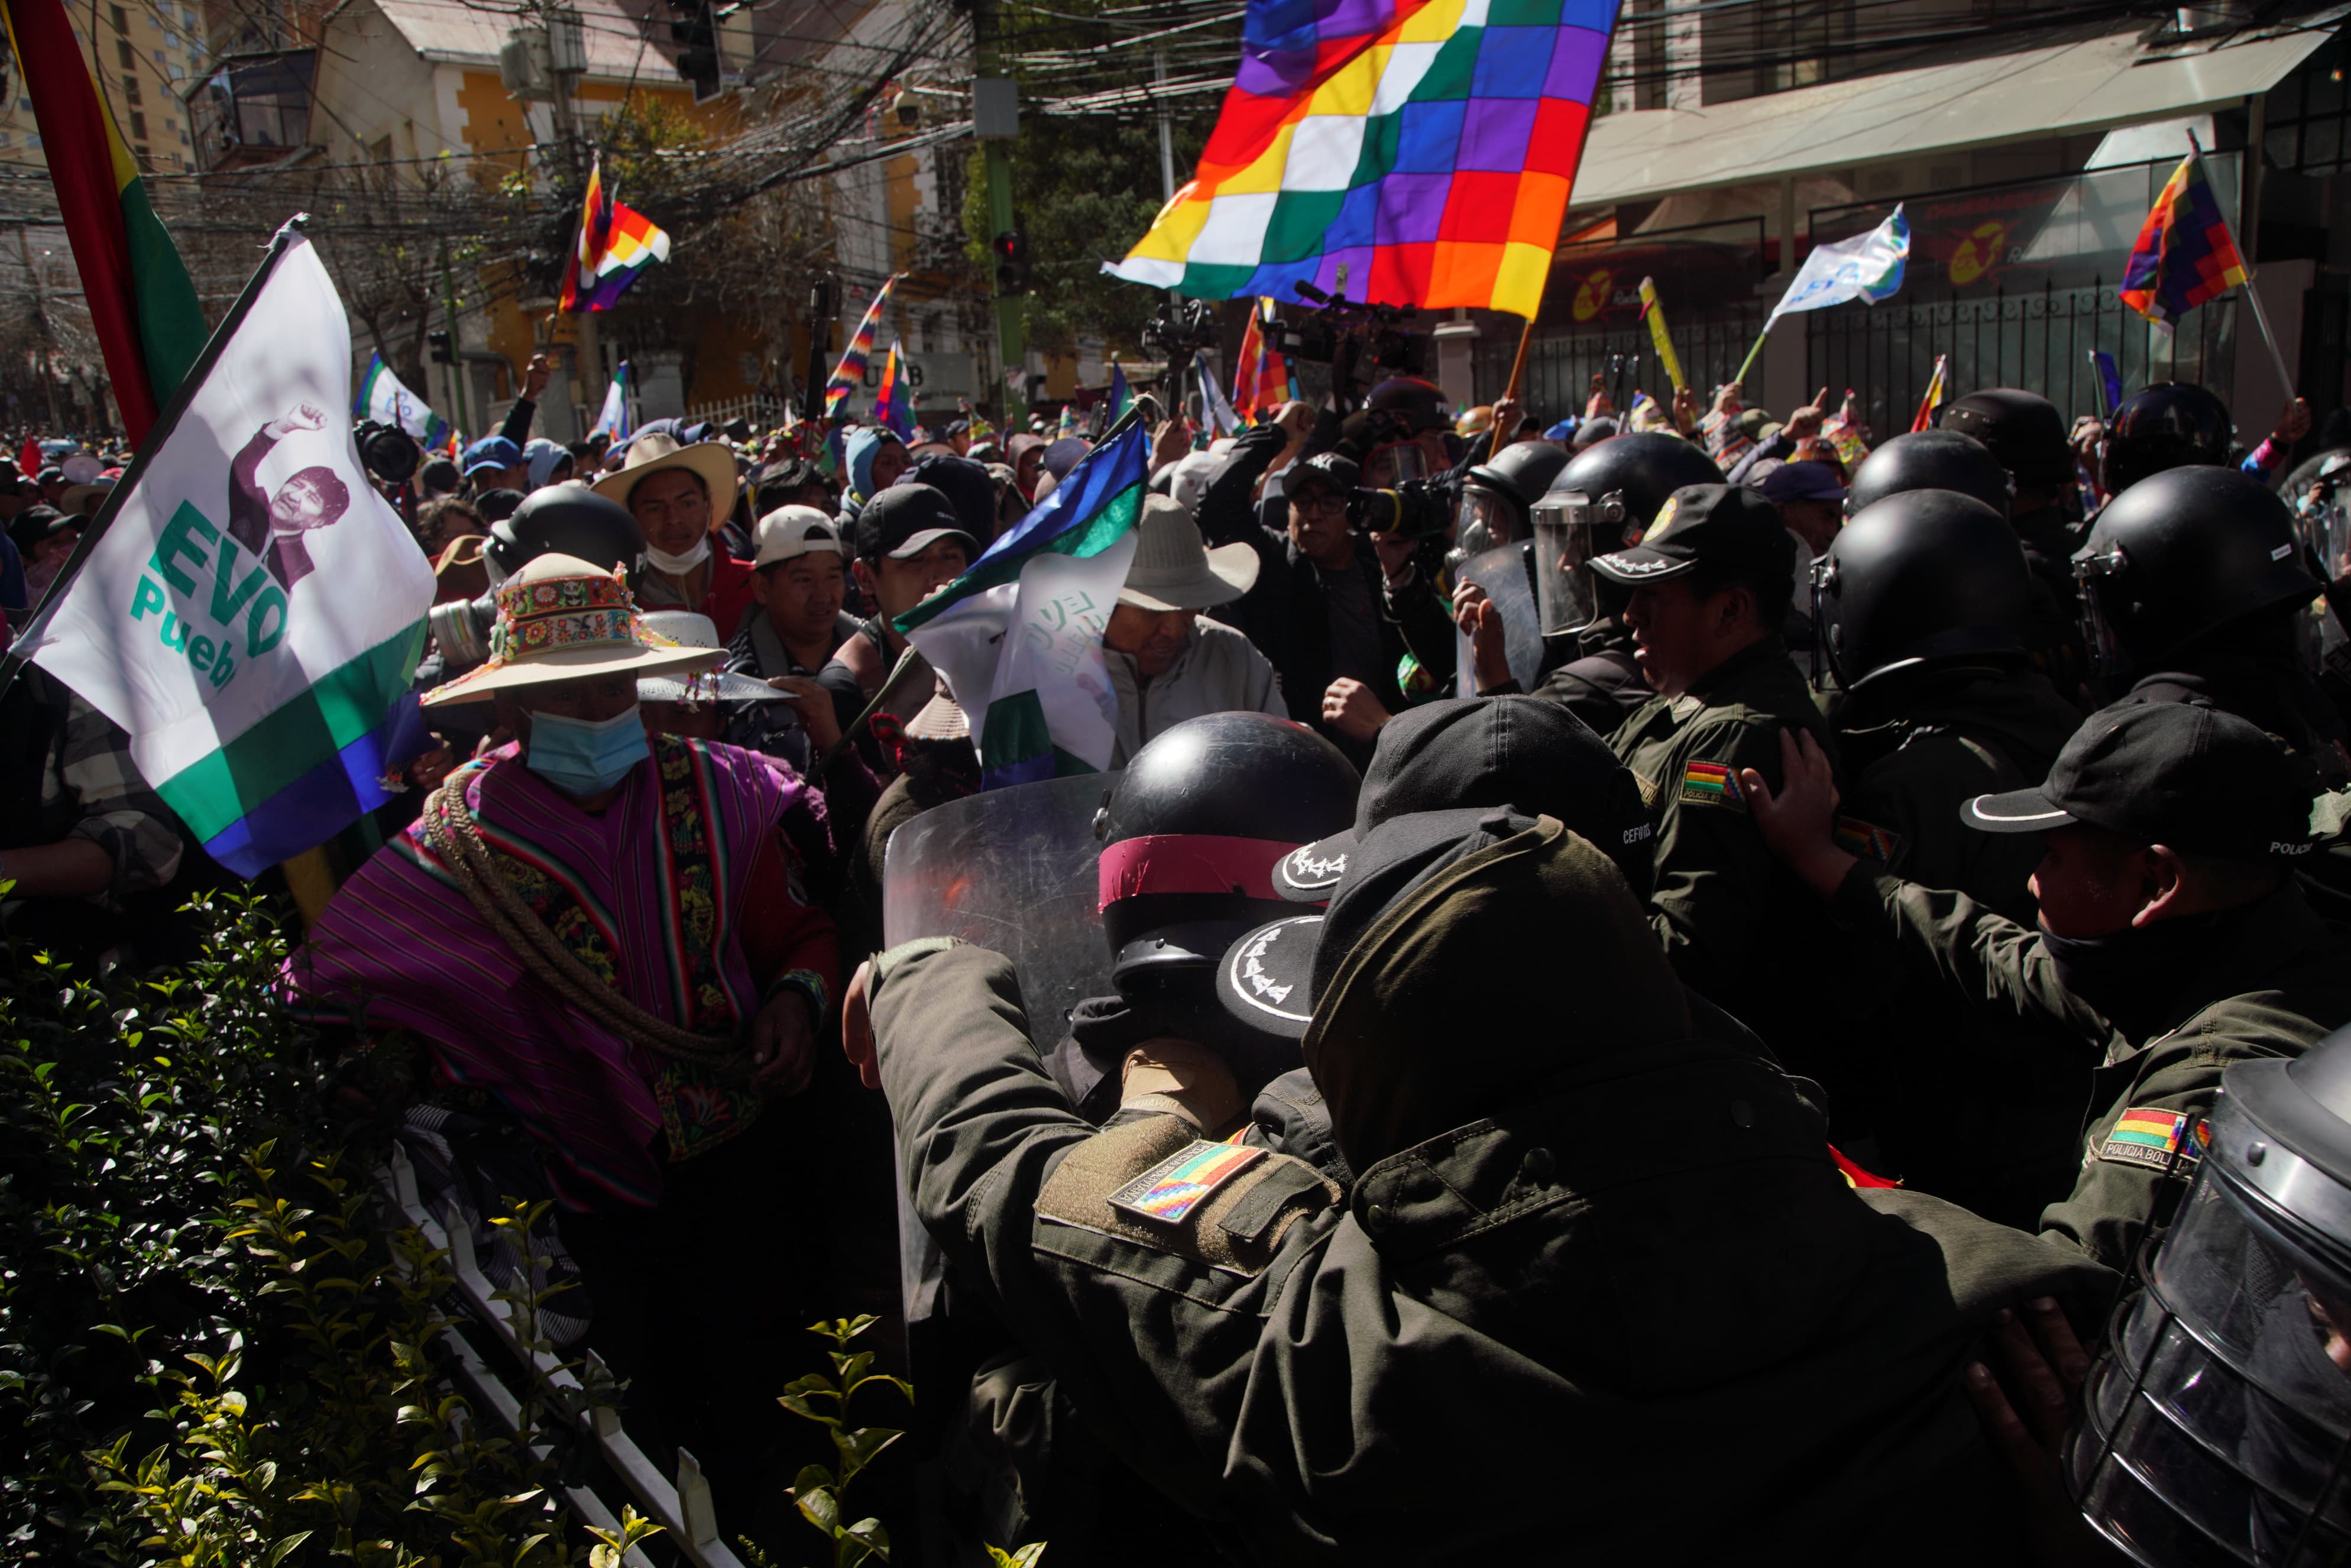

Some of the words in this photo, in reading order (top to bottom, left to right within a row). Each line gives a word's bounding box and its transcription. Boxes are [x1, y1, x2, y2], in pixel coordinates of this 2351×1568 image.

[130, 573, 235, 693] Pueb
[148, 498, 287, 659] EVO
[2107, 1143, 2145, 1160] POLICIA
